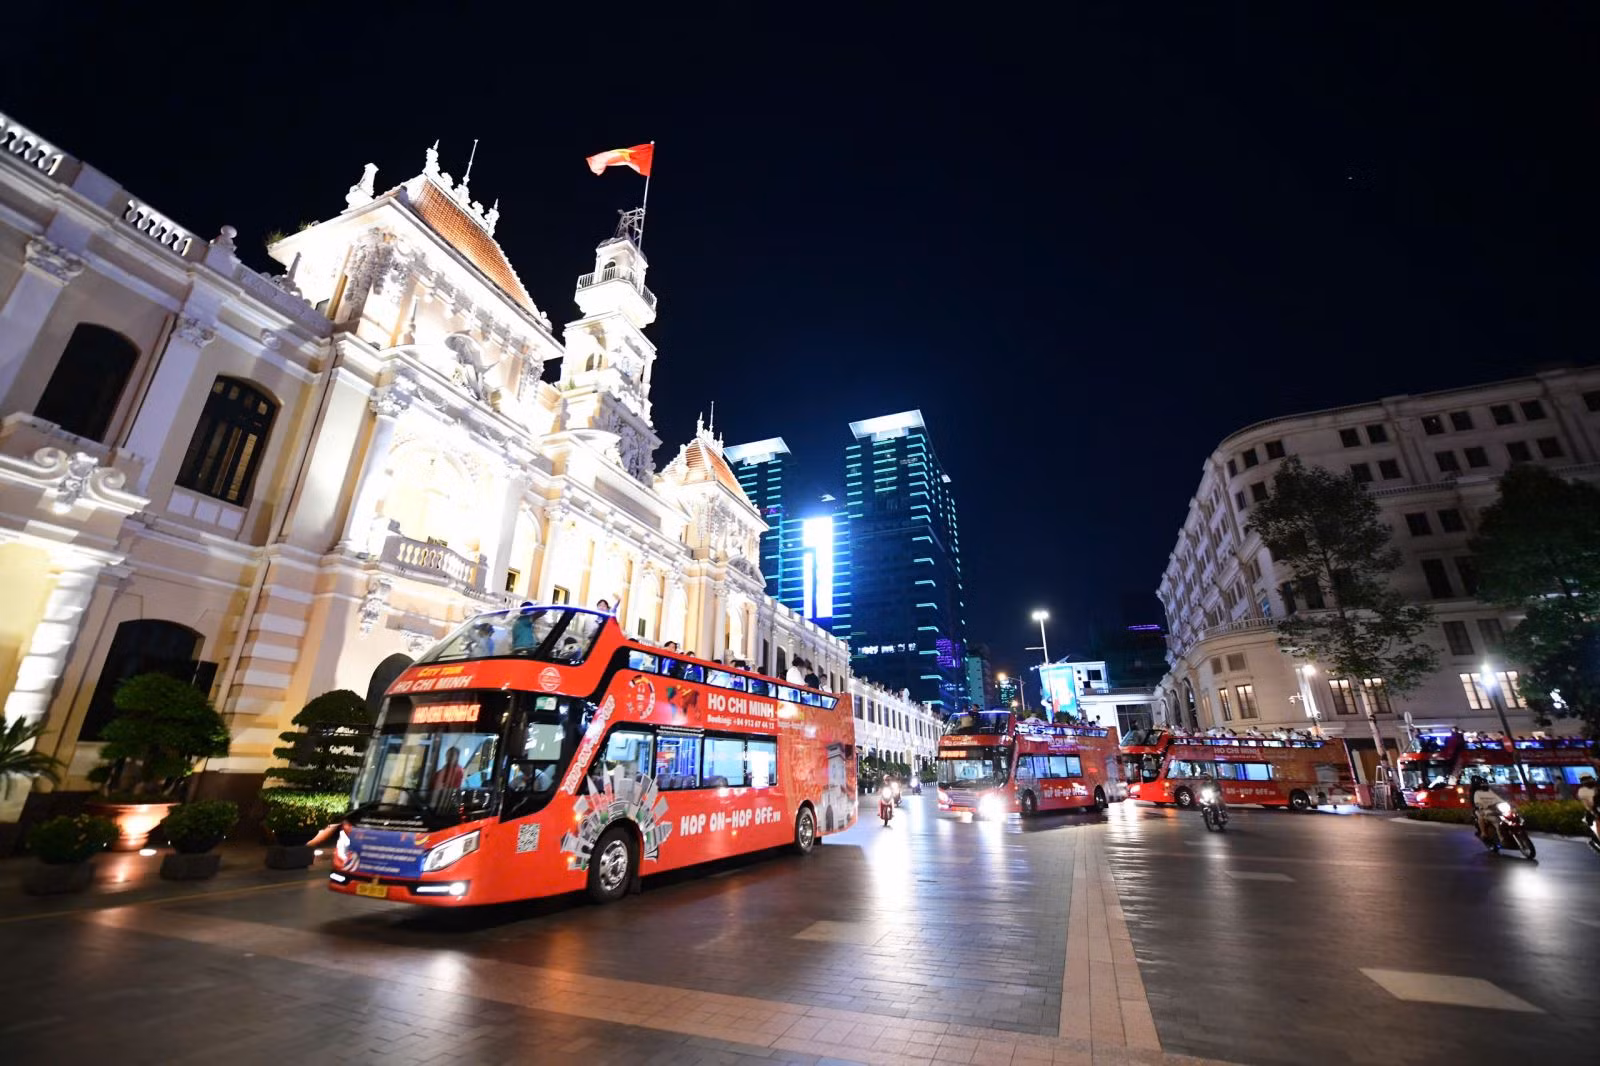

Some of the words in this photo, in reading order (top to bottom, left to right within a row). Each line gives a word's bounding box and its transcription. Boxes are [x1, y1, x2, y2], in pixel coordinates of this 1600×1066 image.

[395, 681, 413, 692] HO
[411, 679, 437, 691] CHI
[433, 675, 473, 690] MINH
[708, 693, 726, 711] HO
[727, 697, 747, 714] CHI
[749, 700, 774, 718] MINH
[680, 813, 706, 837] HOP
[710, 808, 753, 832] ON-HOP
